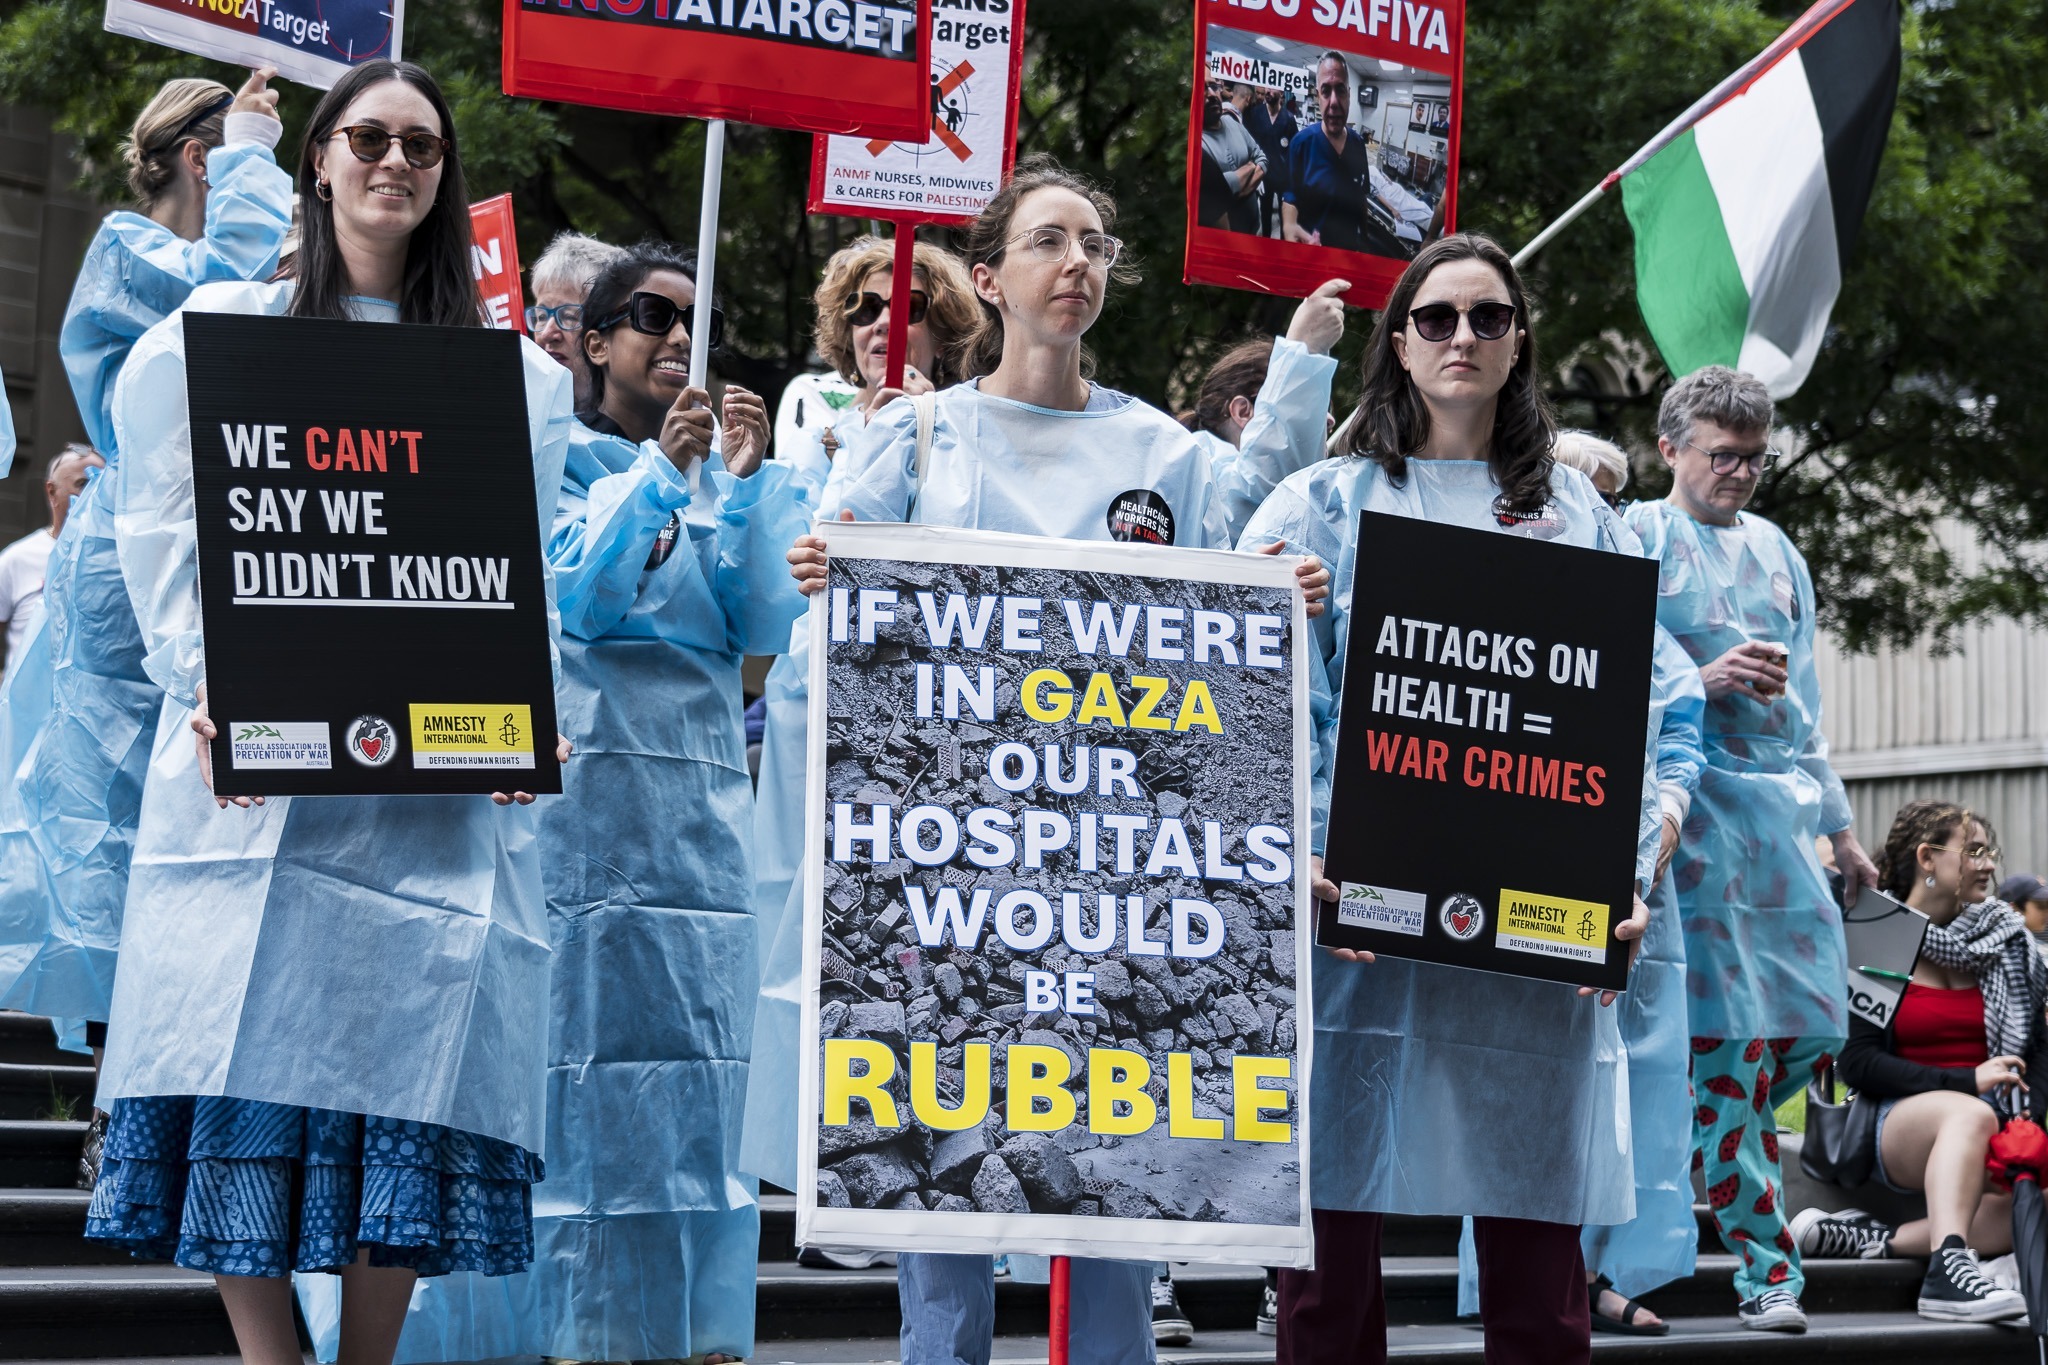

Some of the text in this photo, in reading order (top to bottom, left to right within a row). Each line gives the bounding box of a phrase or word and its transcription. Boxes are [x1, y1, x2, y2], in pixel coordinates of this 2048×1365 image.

[1211, 56, 1310, 92] #NotATarget
[833, 167, 994, 192] ANMF NURSES, MIDWIVES
[835, 185, 845, 196] &
[849, 186, 895, 200] CARERS
[899, 191, 923, 203] FOR
[221, 424, 423, 474] WE CAN’T
[228, 487, 388, 535] SAY WE
[1115, 510, 1157, 531] WORKERS
[1120, 500, 1169, 528] HEALTHCARE
[1541, 512, 1558, 520] ARE
[1115, 521, 1133, 533] NOT
[1134, 526, 1141, 536] A
[233, 551, 509, 601] DIDN’T KNOW
[830, 587, 1285, 669] IF WE WERE
[1375, 615, 1599, 689] ATTACKS ON
[915, 662, 1225, 735] IN GAZA
[1371, 672, 1552, 735] HEALTH =
[423, 716, 486, 732] AMNESTY
[424, 734, 488, 744] INTERNATIONAL
[235, 750, 328, 760] PREVENTION OF WAR
[429, 756, 520, 765] DEFENDING HUMAN RIGHTS
[1366, 729, 1606, 807] WAR CRIMES
[988, 742, 1141, 799] OUR
[832, 802, 1293, 884] HOSPITALS
[904, 885, 1227, 959] WOULD
[1341, 900, 1367, 911] MEDICAL
[1369, 905, 1408, 917] ASSOCIATION
[1341, 907, 1422, 927] PREVENTION OF WAR
[1509, 901, 1568, 923] AMNESTY
[1508, 917, 1566, 935] INTERNATIONAL
[1509, 938, 1592, 959] DEFENDING HUMAN RIGHTS
[1024, 970, 1096, 1015] BE
[821, 1038, 1293, 1144] RUBBLE
